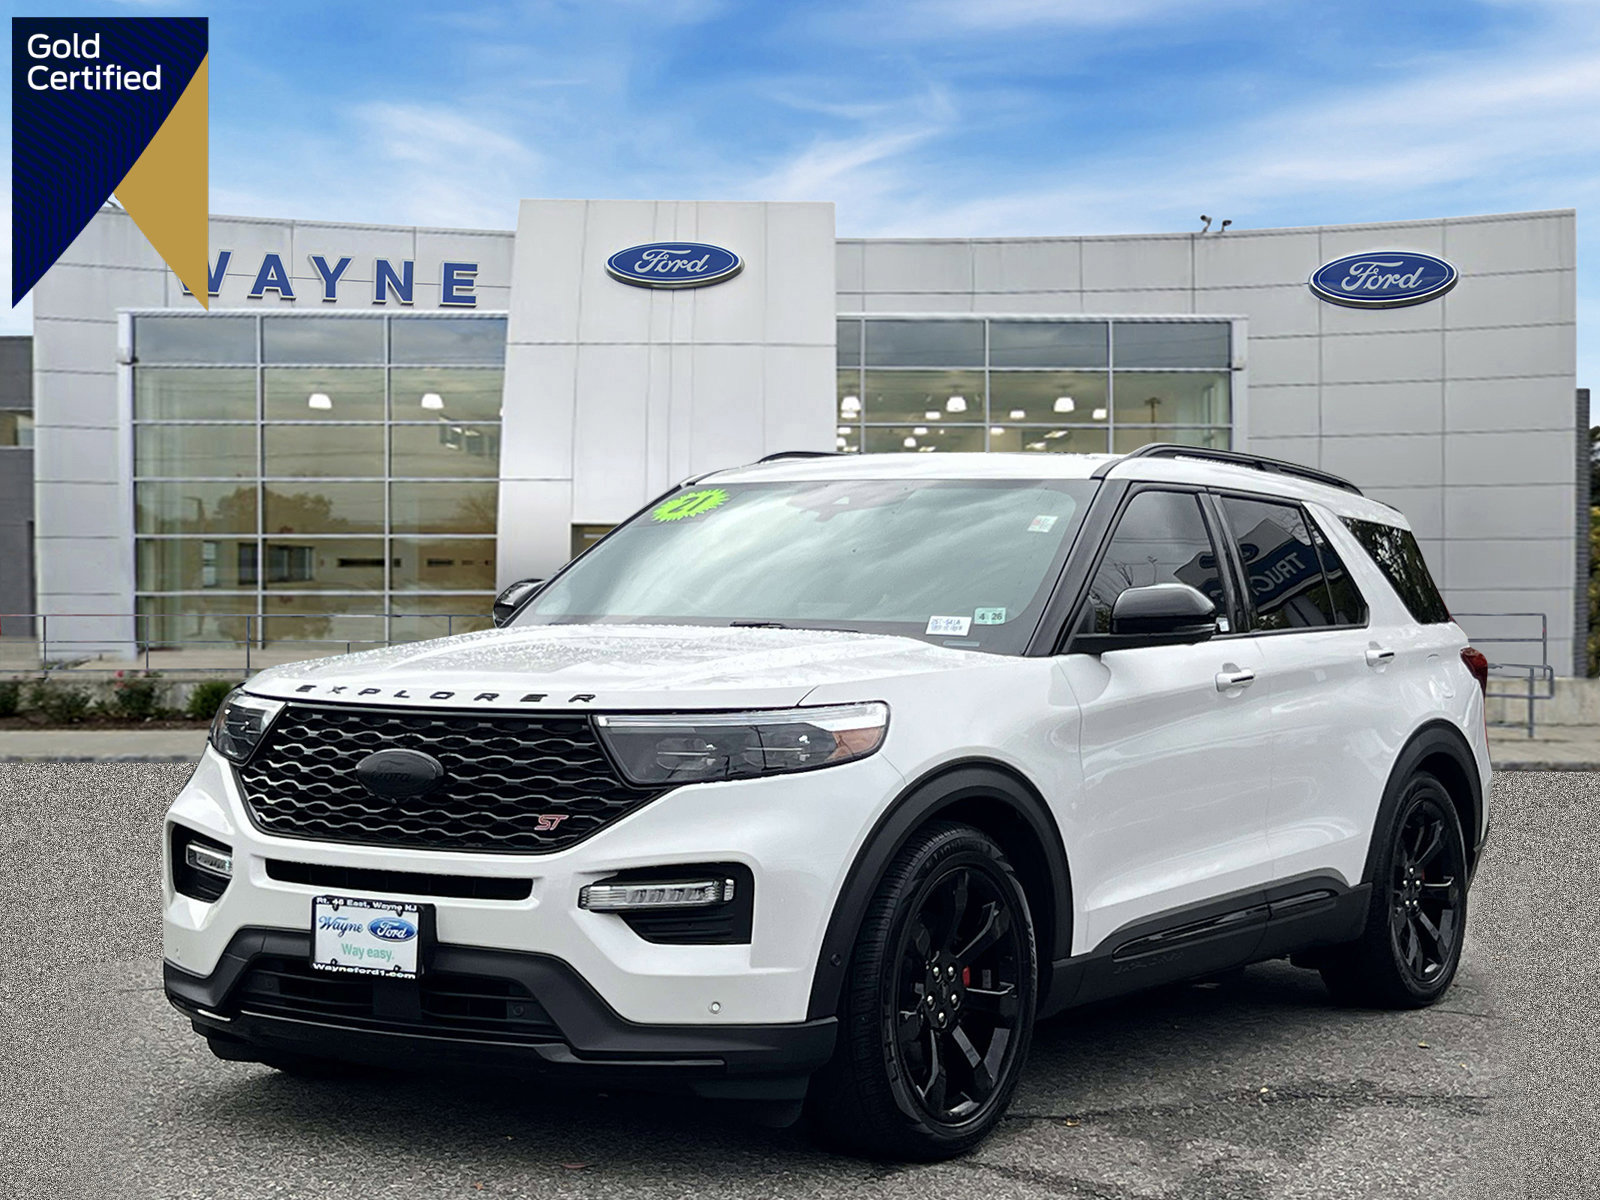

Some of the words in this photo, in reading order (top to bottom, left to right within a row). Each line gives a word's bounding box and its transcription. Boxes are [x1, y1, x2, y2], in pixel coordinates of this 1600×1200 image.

[634, 249, 710, 273] Ford
[1341, 261, 1424, 291] Ford
[667, 495, 713, 513] 21
[991, 612, 1003, 621] 26
[295, 684, 596, 703] EXPLORER
[534, 814, 568, 830] ST
[318, 915, 364, 938] Wayne
[376, 920, 408, 938] Ford
[341, 943, 365, 960] Way
[367, 948, 394, 962] easy.
